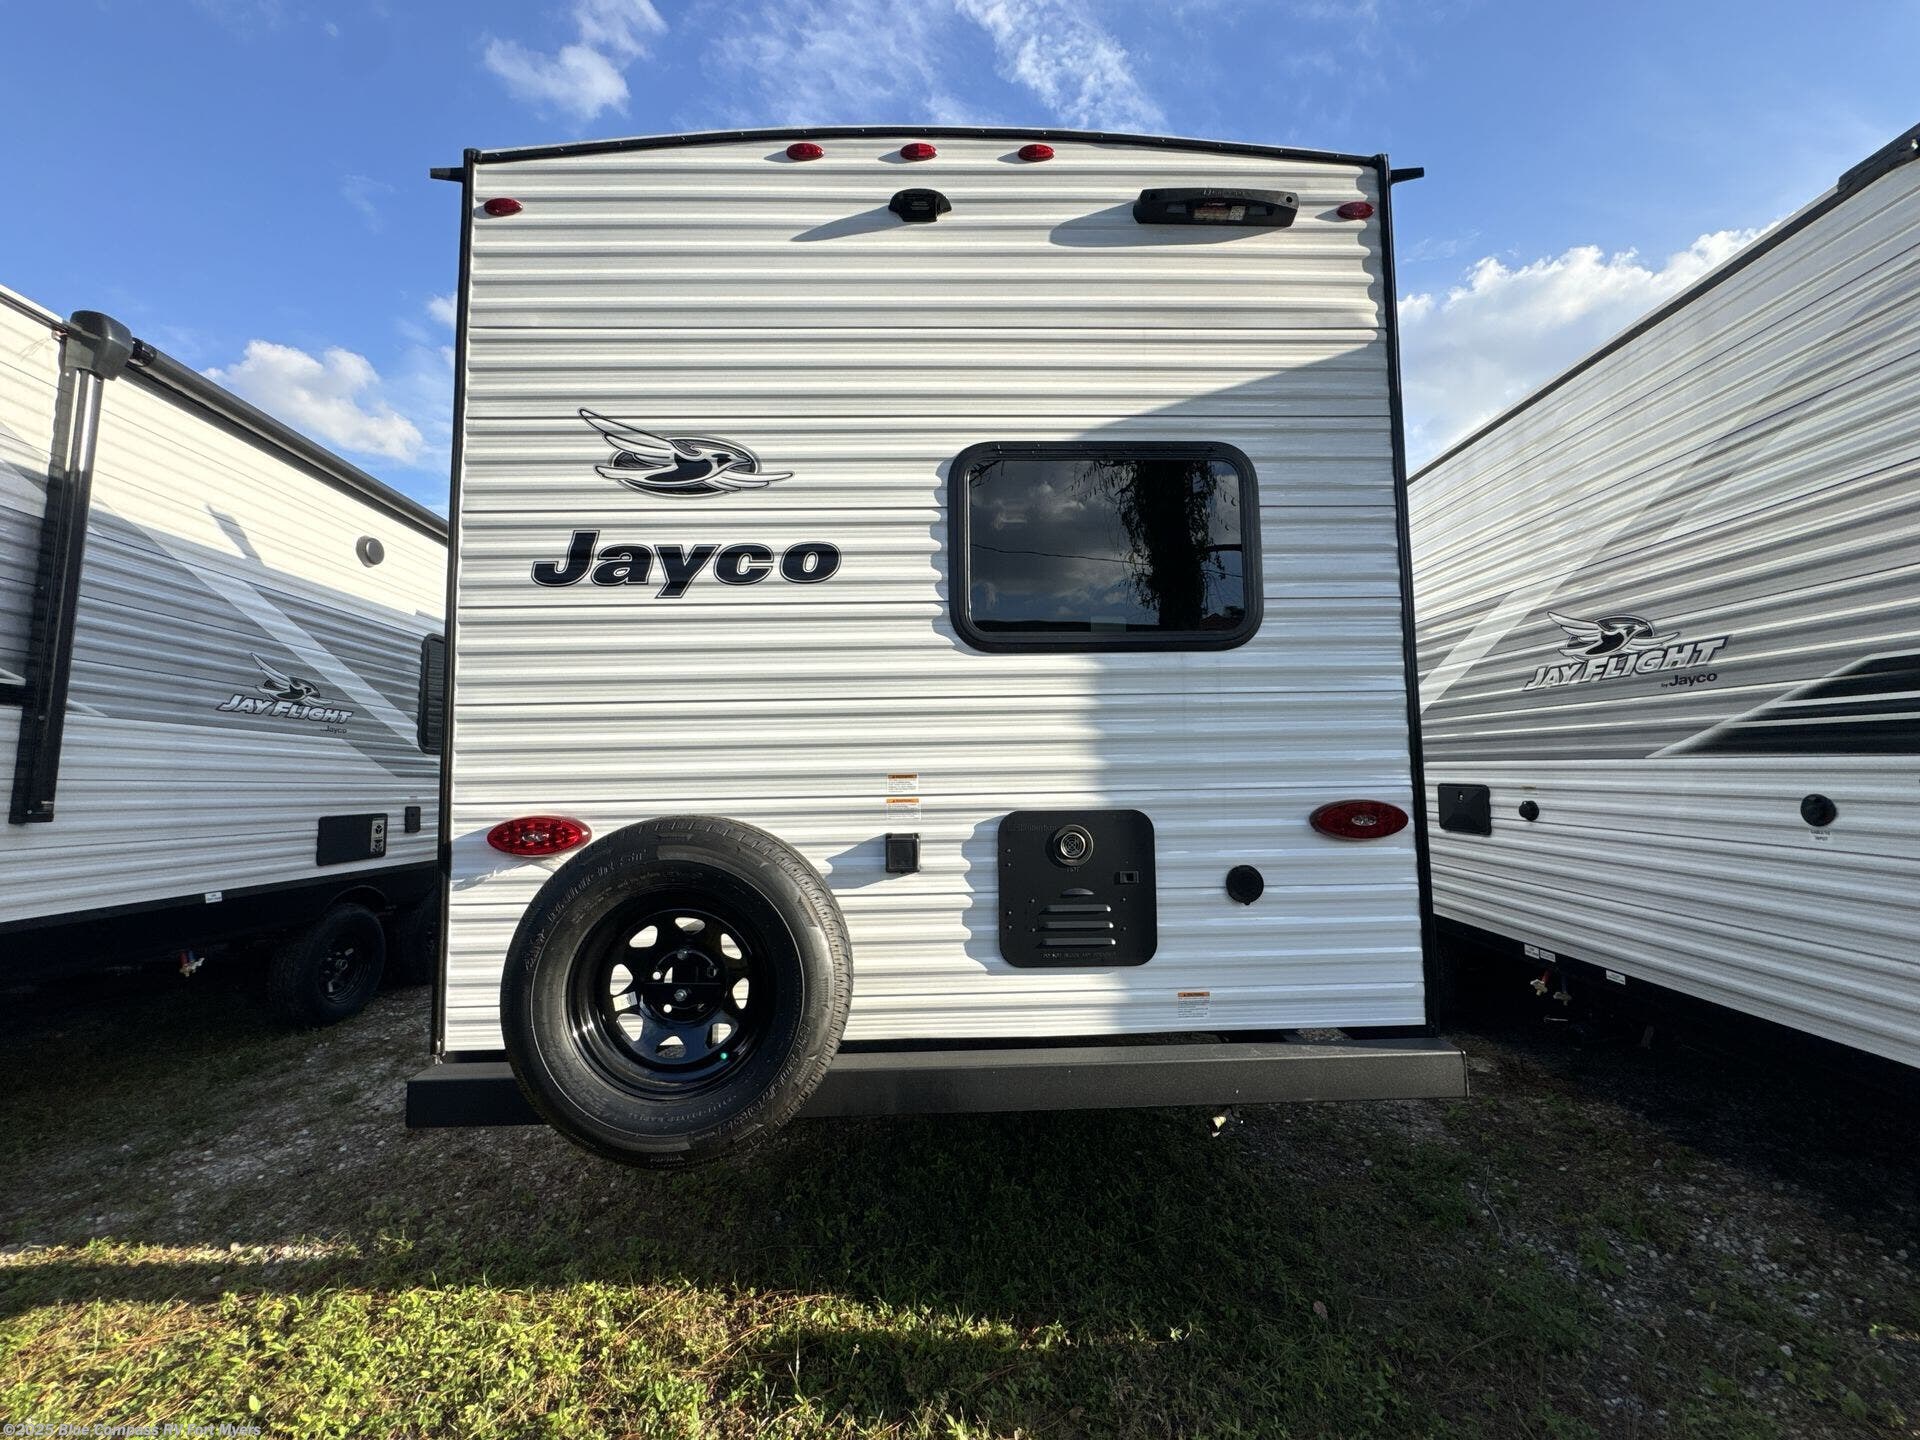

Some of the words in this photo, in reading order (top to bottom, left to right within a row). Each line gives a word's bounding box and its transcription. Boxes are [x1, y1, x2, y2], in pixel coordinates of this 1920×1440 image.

[531, 529, 842, 599] Jayco
[1523, 662, 1584, 691] JAY
[1581, 635, 1731, 682] FLIGHT
[1669, 672, 1718, 688] Jayco
[216, 694, 273, 716] JAY
[271, 700, 354, 724] FLIGHT
[325, 725, 348, 734] Jayco
